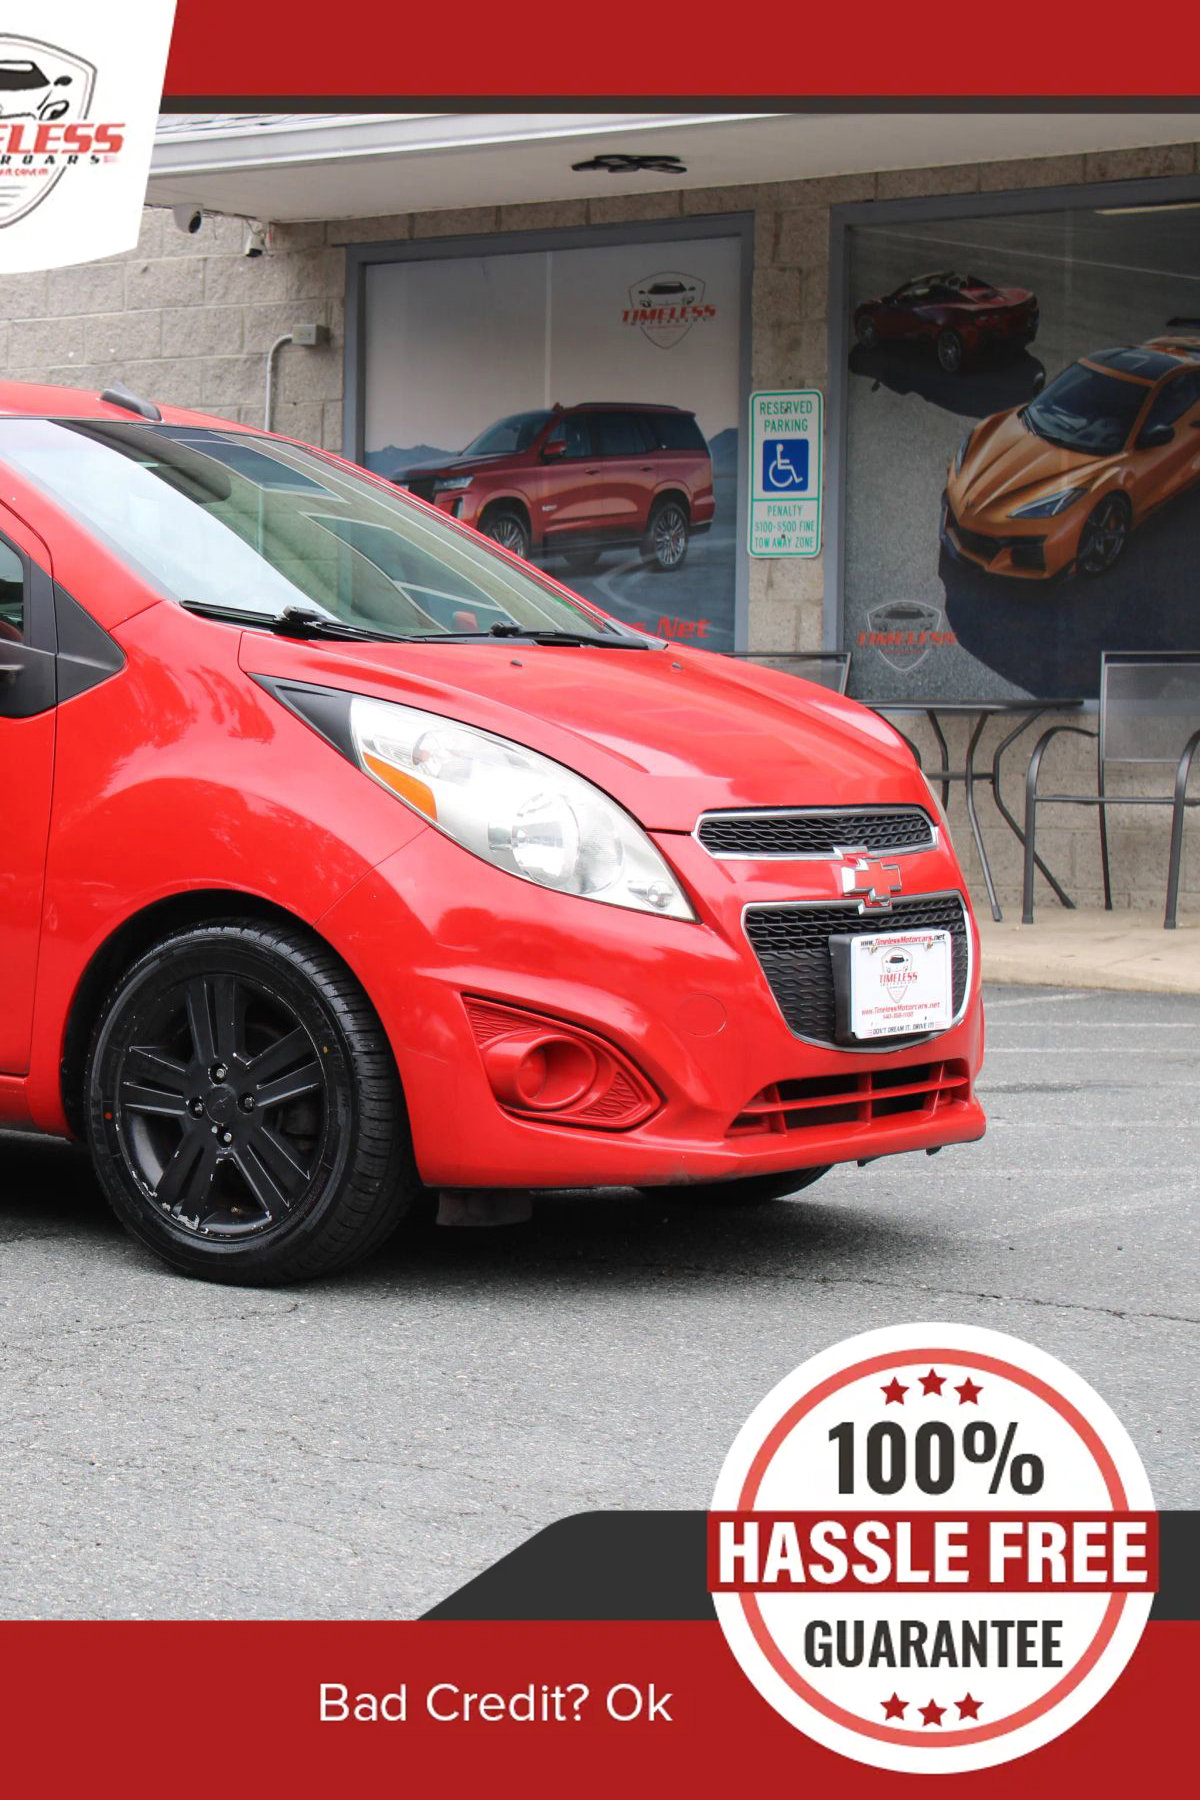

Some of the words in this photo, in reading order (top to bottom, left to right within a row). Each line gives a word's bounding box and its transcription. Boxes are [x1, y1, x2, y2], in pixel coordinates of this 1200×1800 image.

[622, 304, 717, 323] TIMELESS
[760, 400, 813, 415] RESERVED
[764, 418, 808, 432] PARKING
[767, 504, 801, 516] PENALTY
[755, 521, 797, 532] $100-$500
[799, 520, 814, 532] FINE
[755, 537, 770, 548] TOW
[772, 536, 792, 548] AWAY
[795, 536, 813, 548] ZONE
[857, 631, 957, 645] TIMELESS
[879, 971, 918, 984] TIMELESS
